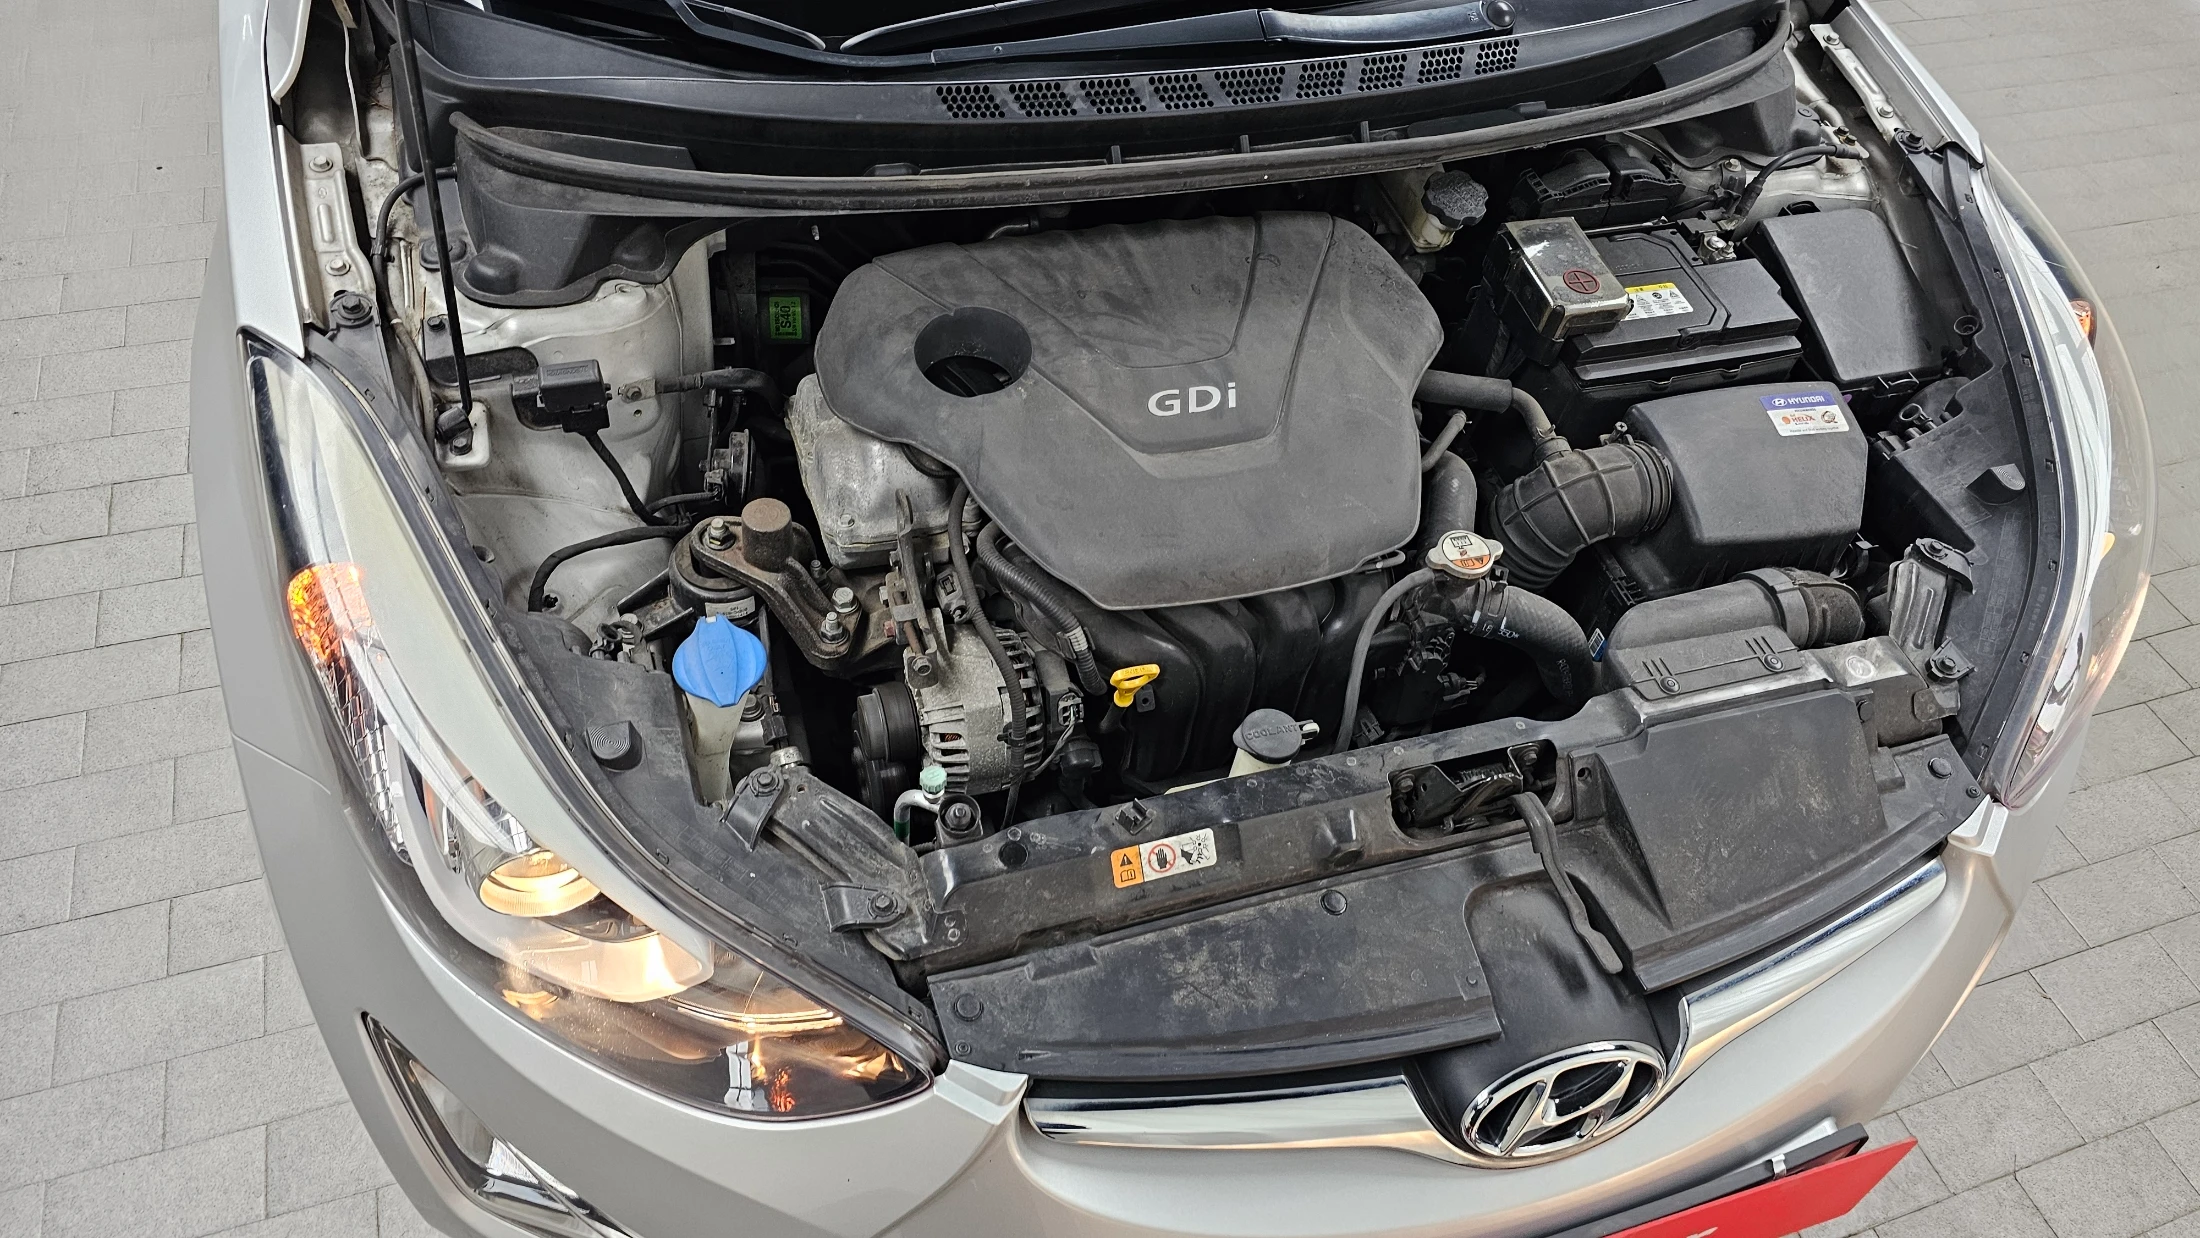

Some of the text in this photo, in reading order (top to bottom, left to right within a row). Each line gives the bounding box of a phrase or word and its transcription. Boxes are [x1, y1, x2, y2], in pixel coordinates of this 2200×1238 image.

[780, 305, 791, 329] S40
[1147, 382, 1236, 417] GDi
[1787, 395, 1826, 405] HYUNDAI
[1245, 724, 1298, 741] COOLANT
